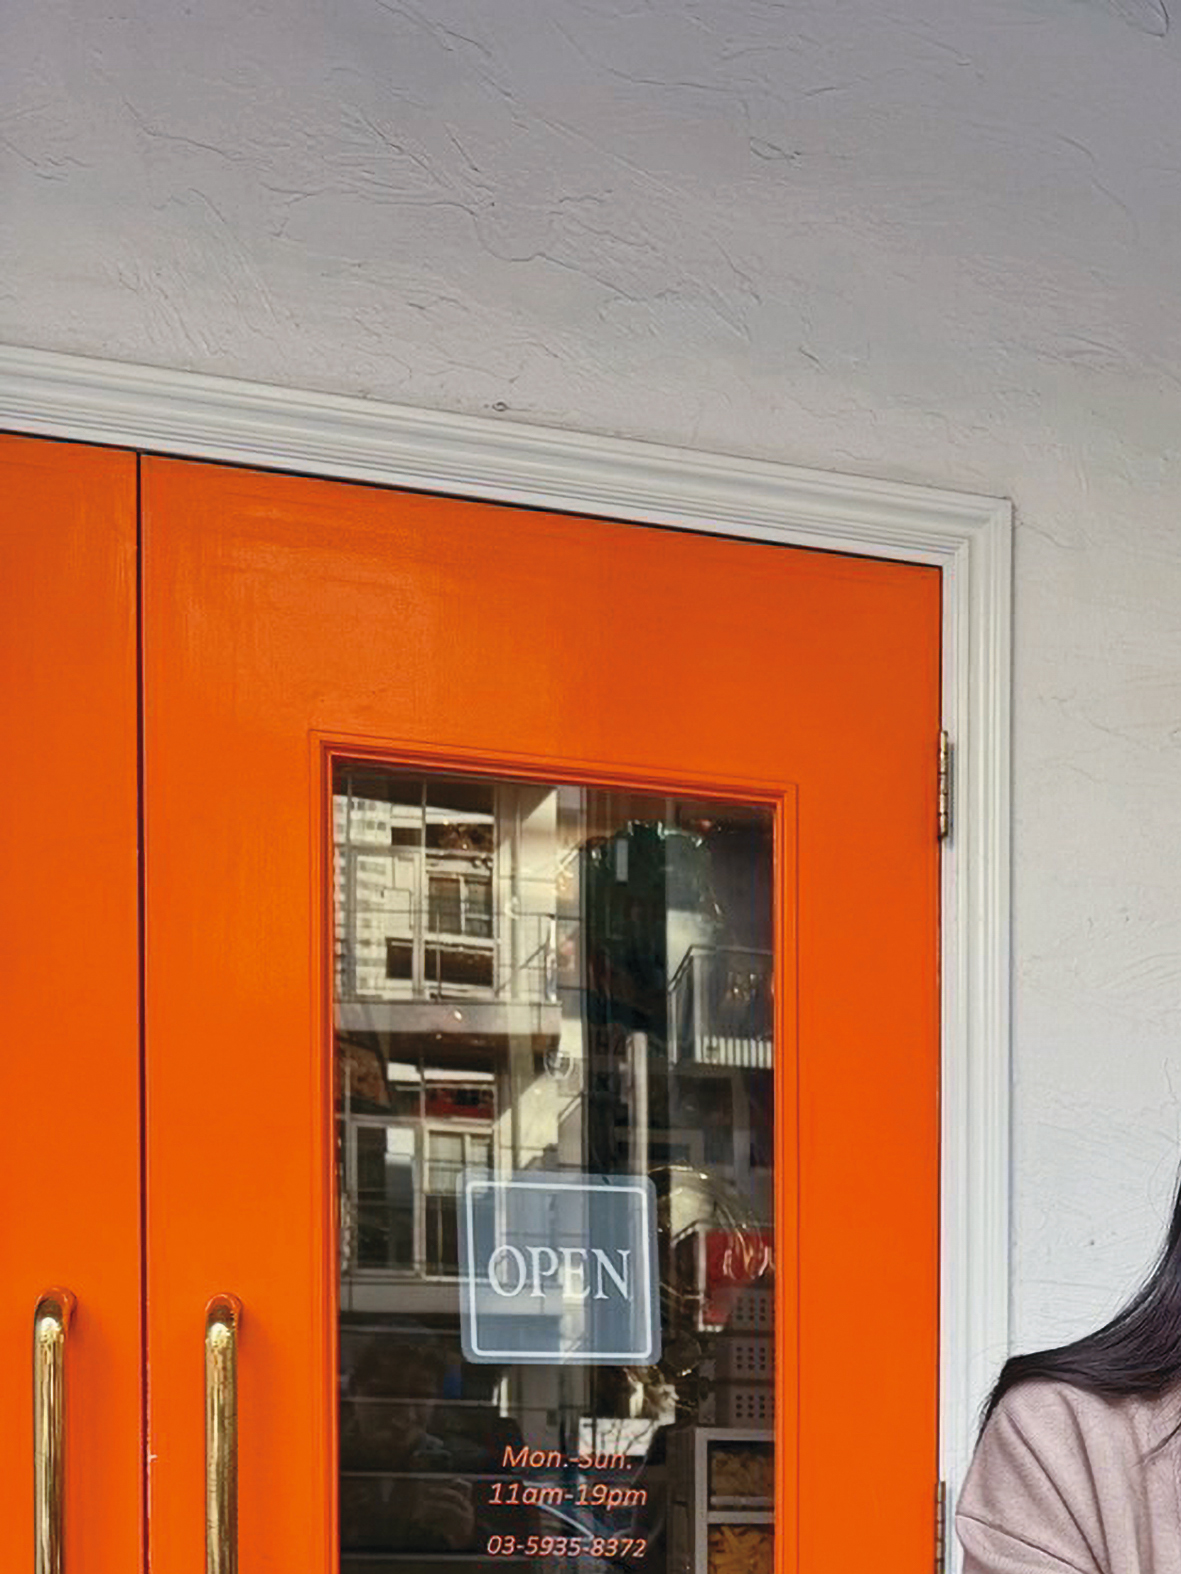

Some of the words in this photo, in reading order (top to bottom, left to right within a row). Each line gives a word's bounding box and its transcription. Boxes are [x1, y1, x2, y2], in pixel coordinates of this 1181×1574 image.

[488, 1245, 631, 1300] OPEN
[488, 1482, 648, 1511] 11am-19pm
[487, 1535, 648, 1558] 03-5935-8372
